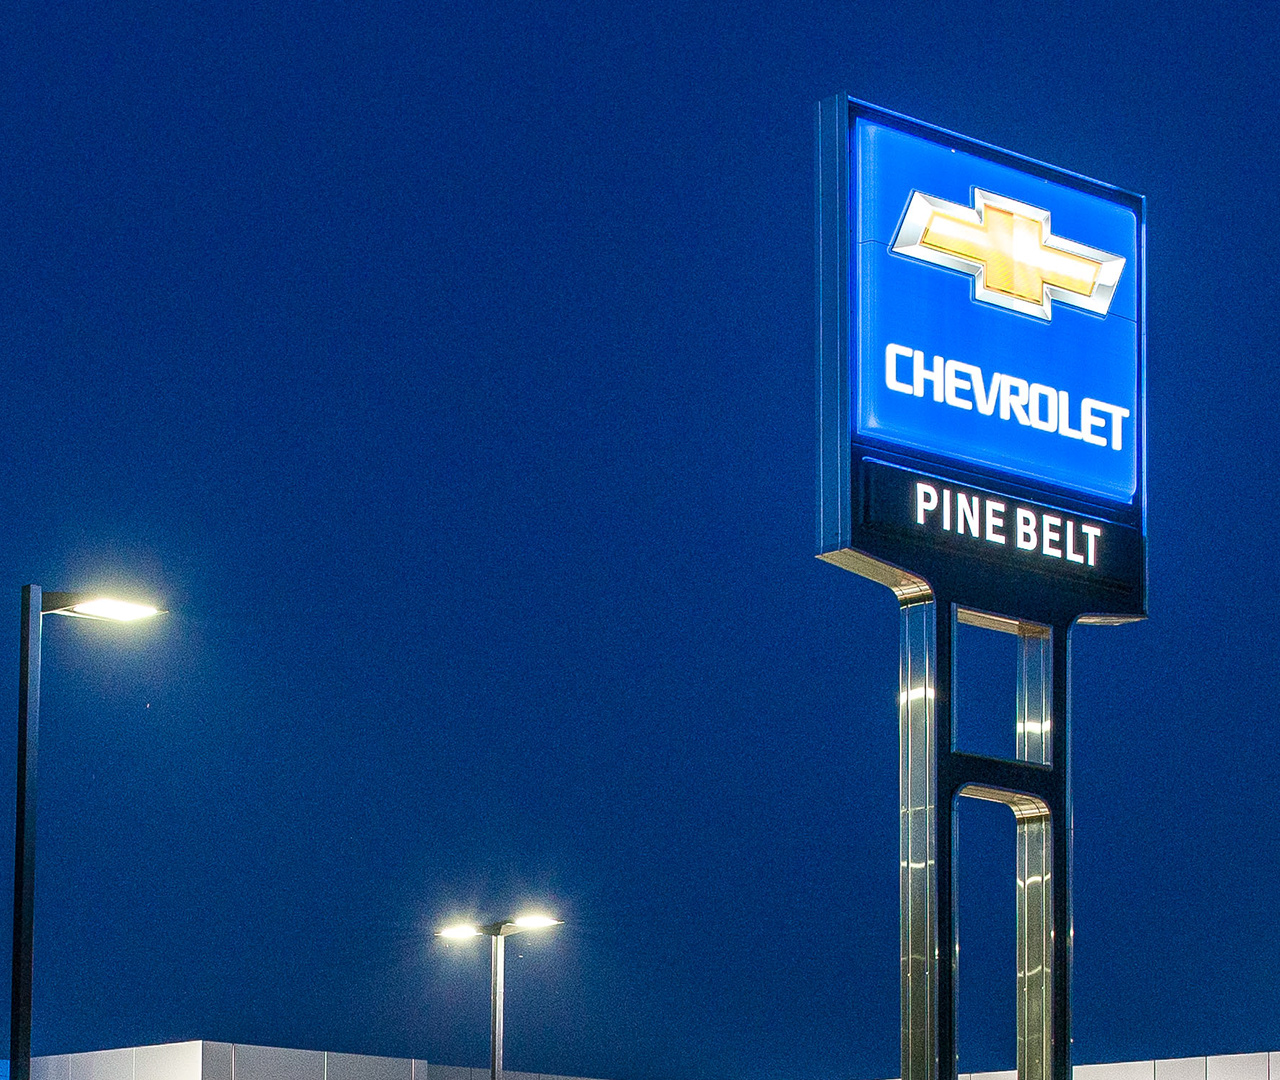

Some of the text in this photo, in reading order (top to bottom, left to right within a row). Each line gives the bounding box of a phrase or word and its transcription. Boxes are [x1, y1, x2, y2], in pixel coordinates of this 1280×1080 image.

[885, 343, 1130, 451] CHEVROLET
[916, 482, 1101, 567] PINE BELT
